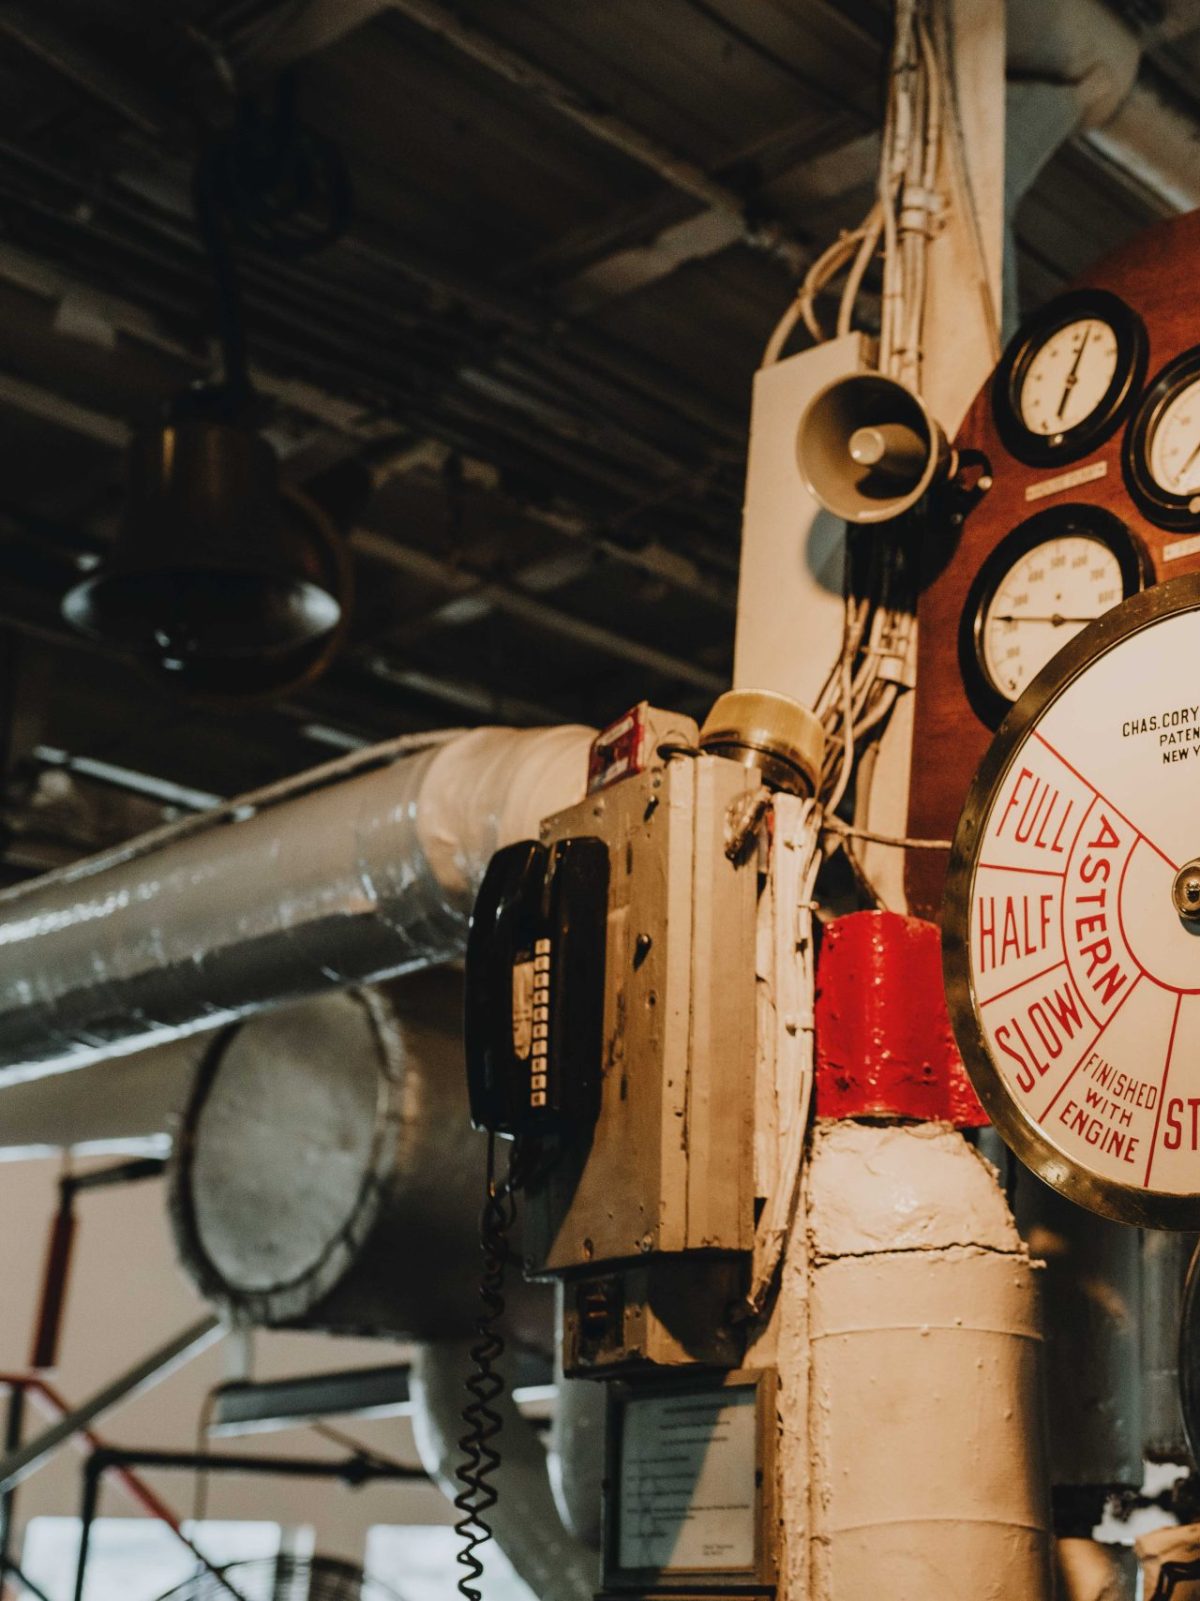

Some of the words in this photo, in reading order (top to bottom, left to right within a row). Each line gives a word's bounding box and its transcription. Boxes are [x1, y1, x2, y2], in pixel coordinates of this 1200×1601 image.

[1162, 747, 1189, 764] NEW
[996, 769, 1074, 854] FULL
[978, 894, 1054, 974] HALF
[1074, 815, 1128, 1005] ASTERN
[994, 982, 1084, 1094] SLOW
[1082, 1053, 1158, 1111] FINISHED
[1085, 1090, 1134, 1126] WITH
[1059, 1099, 1139, 1165] ENGINE
